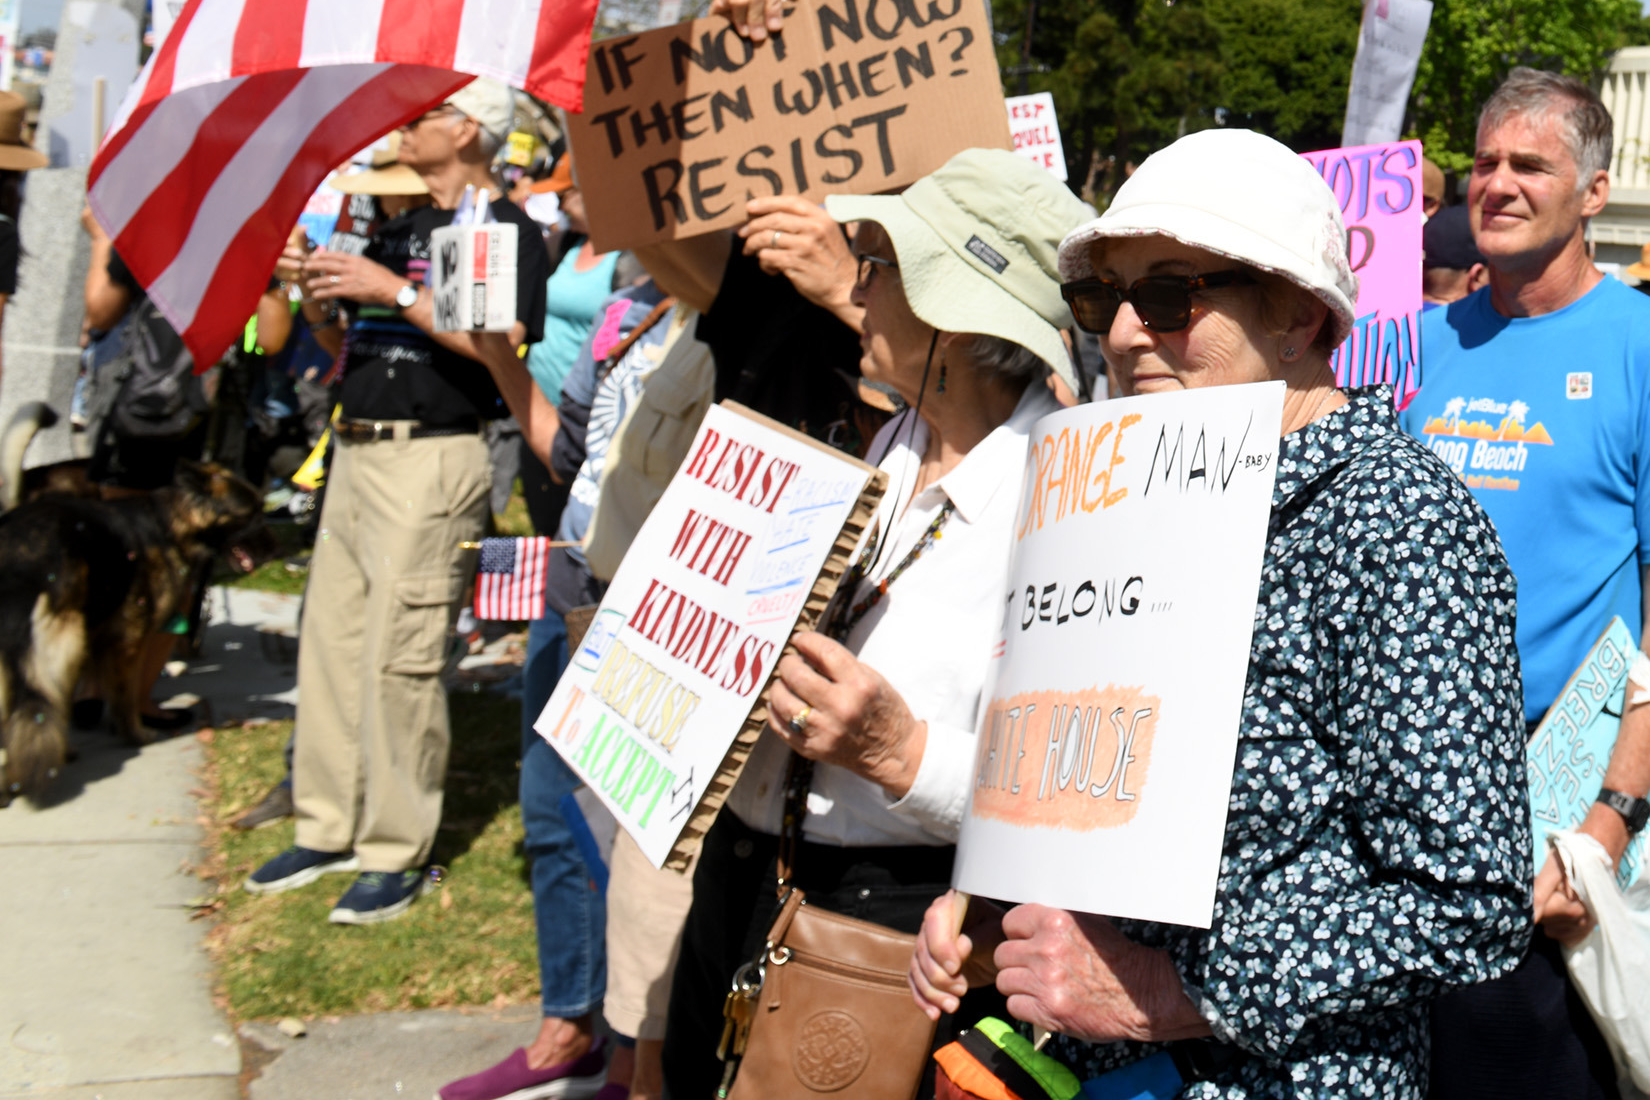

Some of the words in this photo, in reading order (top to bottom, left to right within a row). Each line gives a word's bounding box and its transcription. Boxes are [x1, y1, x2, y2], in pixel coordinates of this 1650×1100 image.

[589, 85, 755, 159] THEN
[774, 27, 974, 115] WHEN?
[593, 37, 646, 95] IF
[669, 6, 796, 86] NOT
[641, 104, 908, 232] RESIST
[441, 239, 458, 287] NO
[1466, 397, 1509, 415] jetBlue
[686, 428, 801, 513] RESIST
[1018, 413, 1142, 541] ORANGE
[1470, 440, 1529, 472] Beach
[669, 509, 752, 587] WITH
[627, 578, 775, 698] KINDNESS
[592, 639, 701, 753] REFUSE
[1528, 638, 1626, 798] BREEZE
[572, 713, 677, 829] ACCEPT
[1037, 704, 1152, 801] HOUSE
[1535, 738, 1595, 825] SEA
